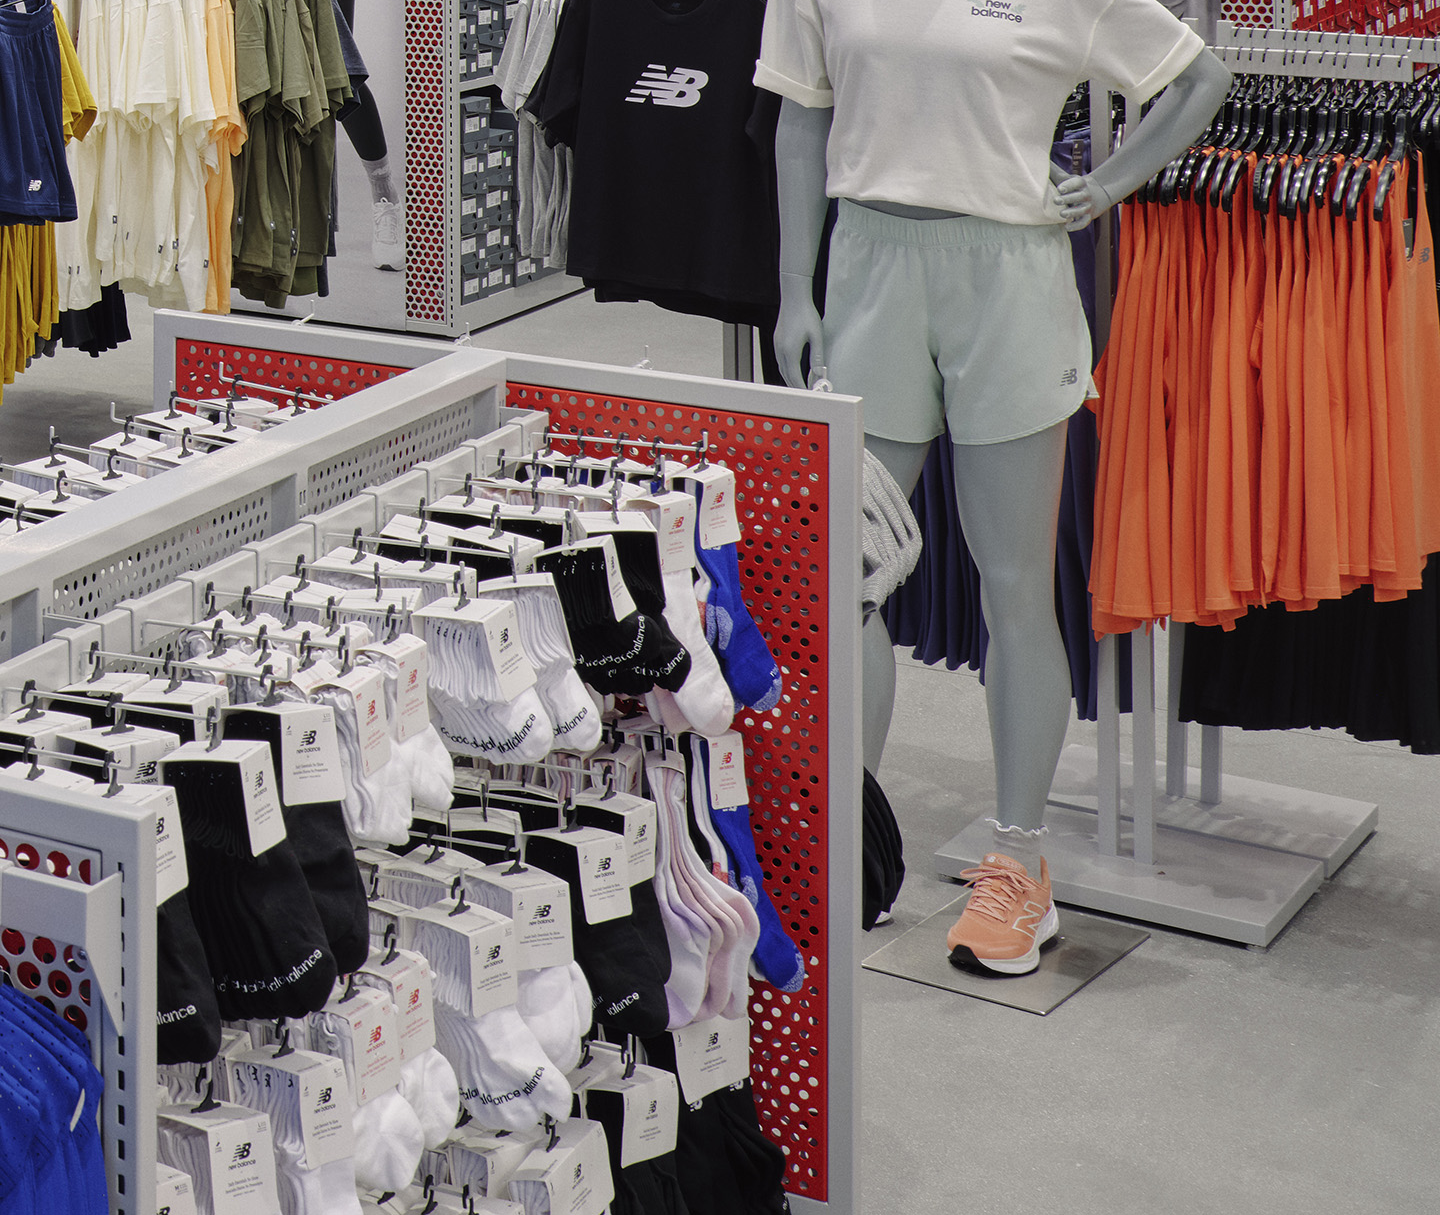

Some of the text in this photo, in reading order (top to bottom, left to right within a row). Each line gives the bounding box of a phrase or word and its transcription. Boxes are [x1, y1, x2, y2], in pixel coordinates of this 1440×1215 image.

[985, 0, 1011, 10] new
[971, 6, 1022, 23] balance
[624, 64, 709, 108] NB
[28, 179, 42, 191] NB
[1060, 368, 1078, 387] NB
[300, 730, 317, 746] NB
[135, 761, 158, 779] NB
[597, 857, 611, 872] NB
[532, 904, 552, 919] NB
[487, 944, 501, 962] NB
[408, 988, 420, 1007] NB
[369, 1026, 382, 1044] NB
[317, 1087, 332, 1106] NB
[232, 1142, 252, 1162] NB
